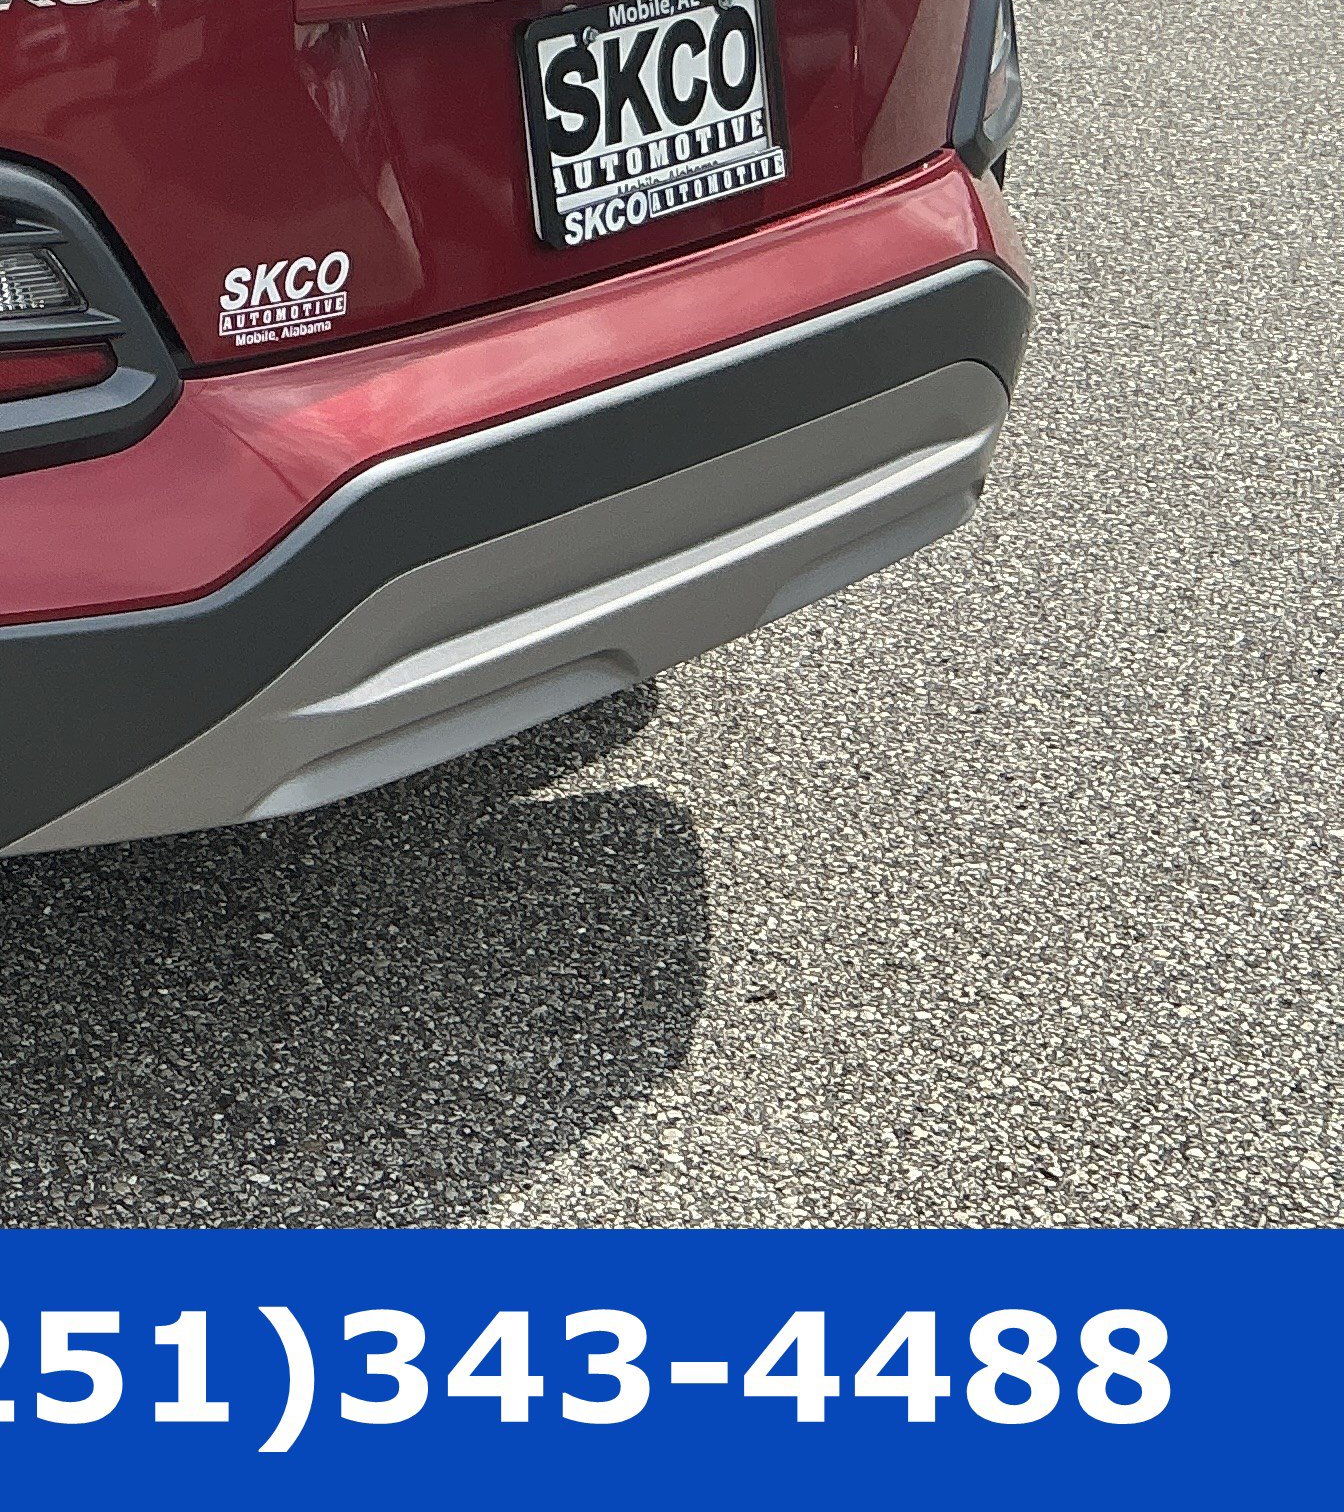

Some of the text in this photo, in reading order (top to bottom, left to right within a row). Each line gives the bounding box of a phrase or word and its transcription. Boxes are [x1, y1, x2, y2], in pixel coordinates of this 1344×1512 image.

[544, 6, 757, 158] SKCO
[552, 112, 764, 194] AUTOMOTIVE
[564, 154, 784, 246] SKCO AUTOMOTIVE
[219, 250, 350, 311] SKCO
[222, 297, 344, 330] AUTOMOTIVE
[235, 320, 332, 347] Mobile, Alabama
